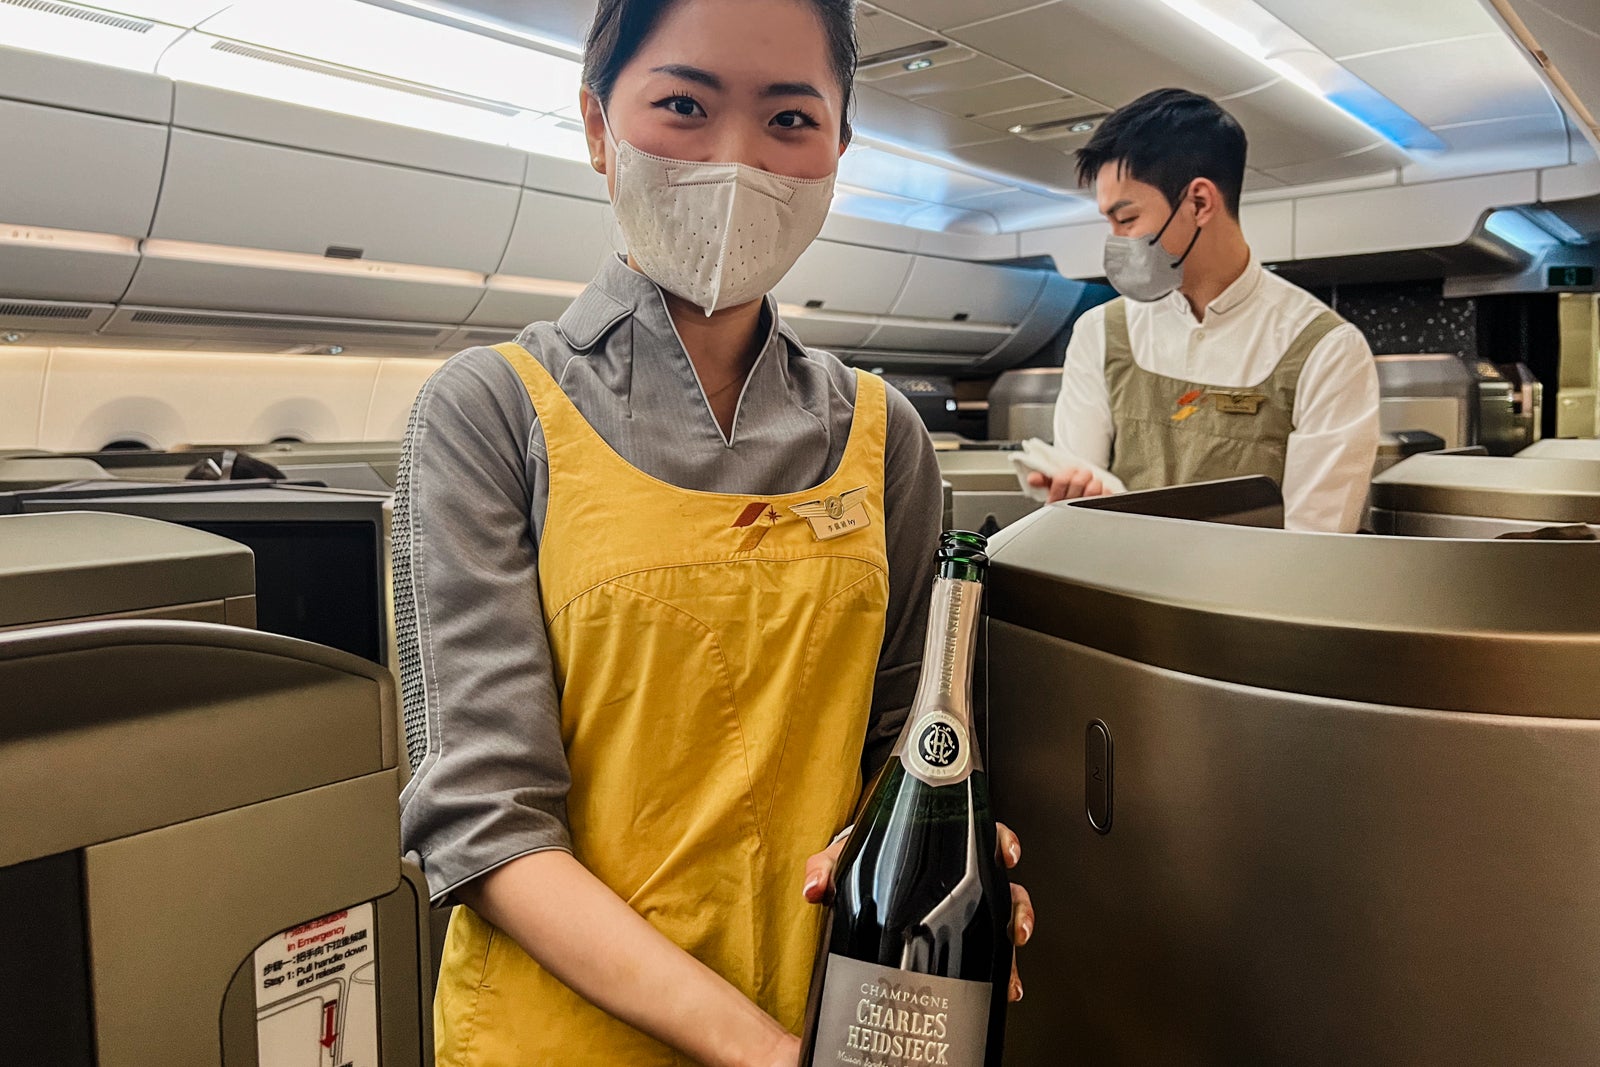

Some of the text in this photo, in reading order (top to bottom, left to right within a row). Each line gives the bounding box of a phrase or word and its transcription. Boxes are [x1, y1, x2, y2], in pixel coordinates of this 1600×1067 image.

[946, 583, 963, 633] CHARLES
[297, 925, 346, 949] Emergency
[263, 944, 368, 988] Step 1: Pull handle down
[297, 963, 346, 987] and release
[860, 983, 949, 1010] CHAMPAGNE
[856, 998, 948, 1040] CHARLES
[846, 1025, 950, 1066] HEIDSIECK
